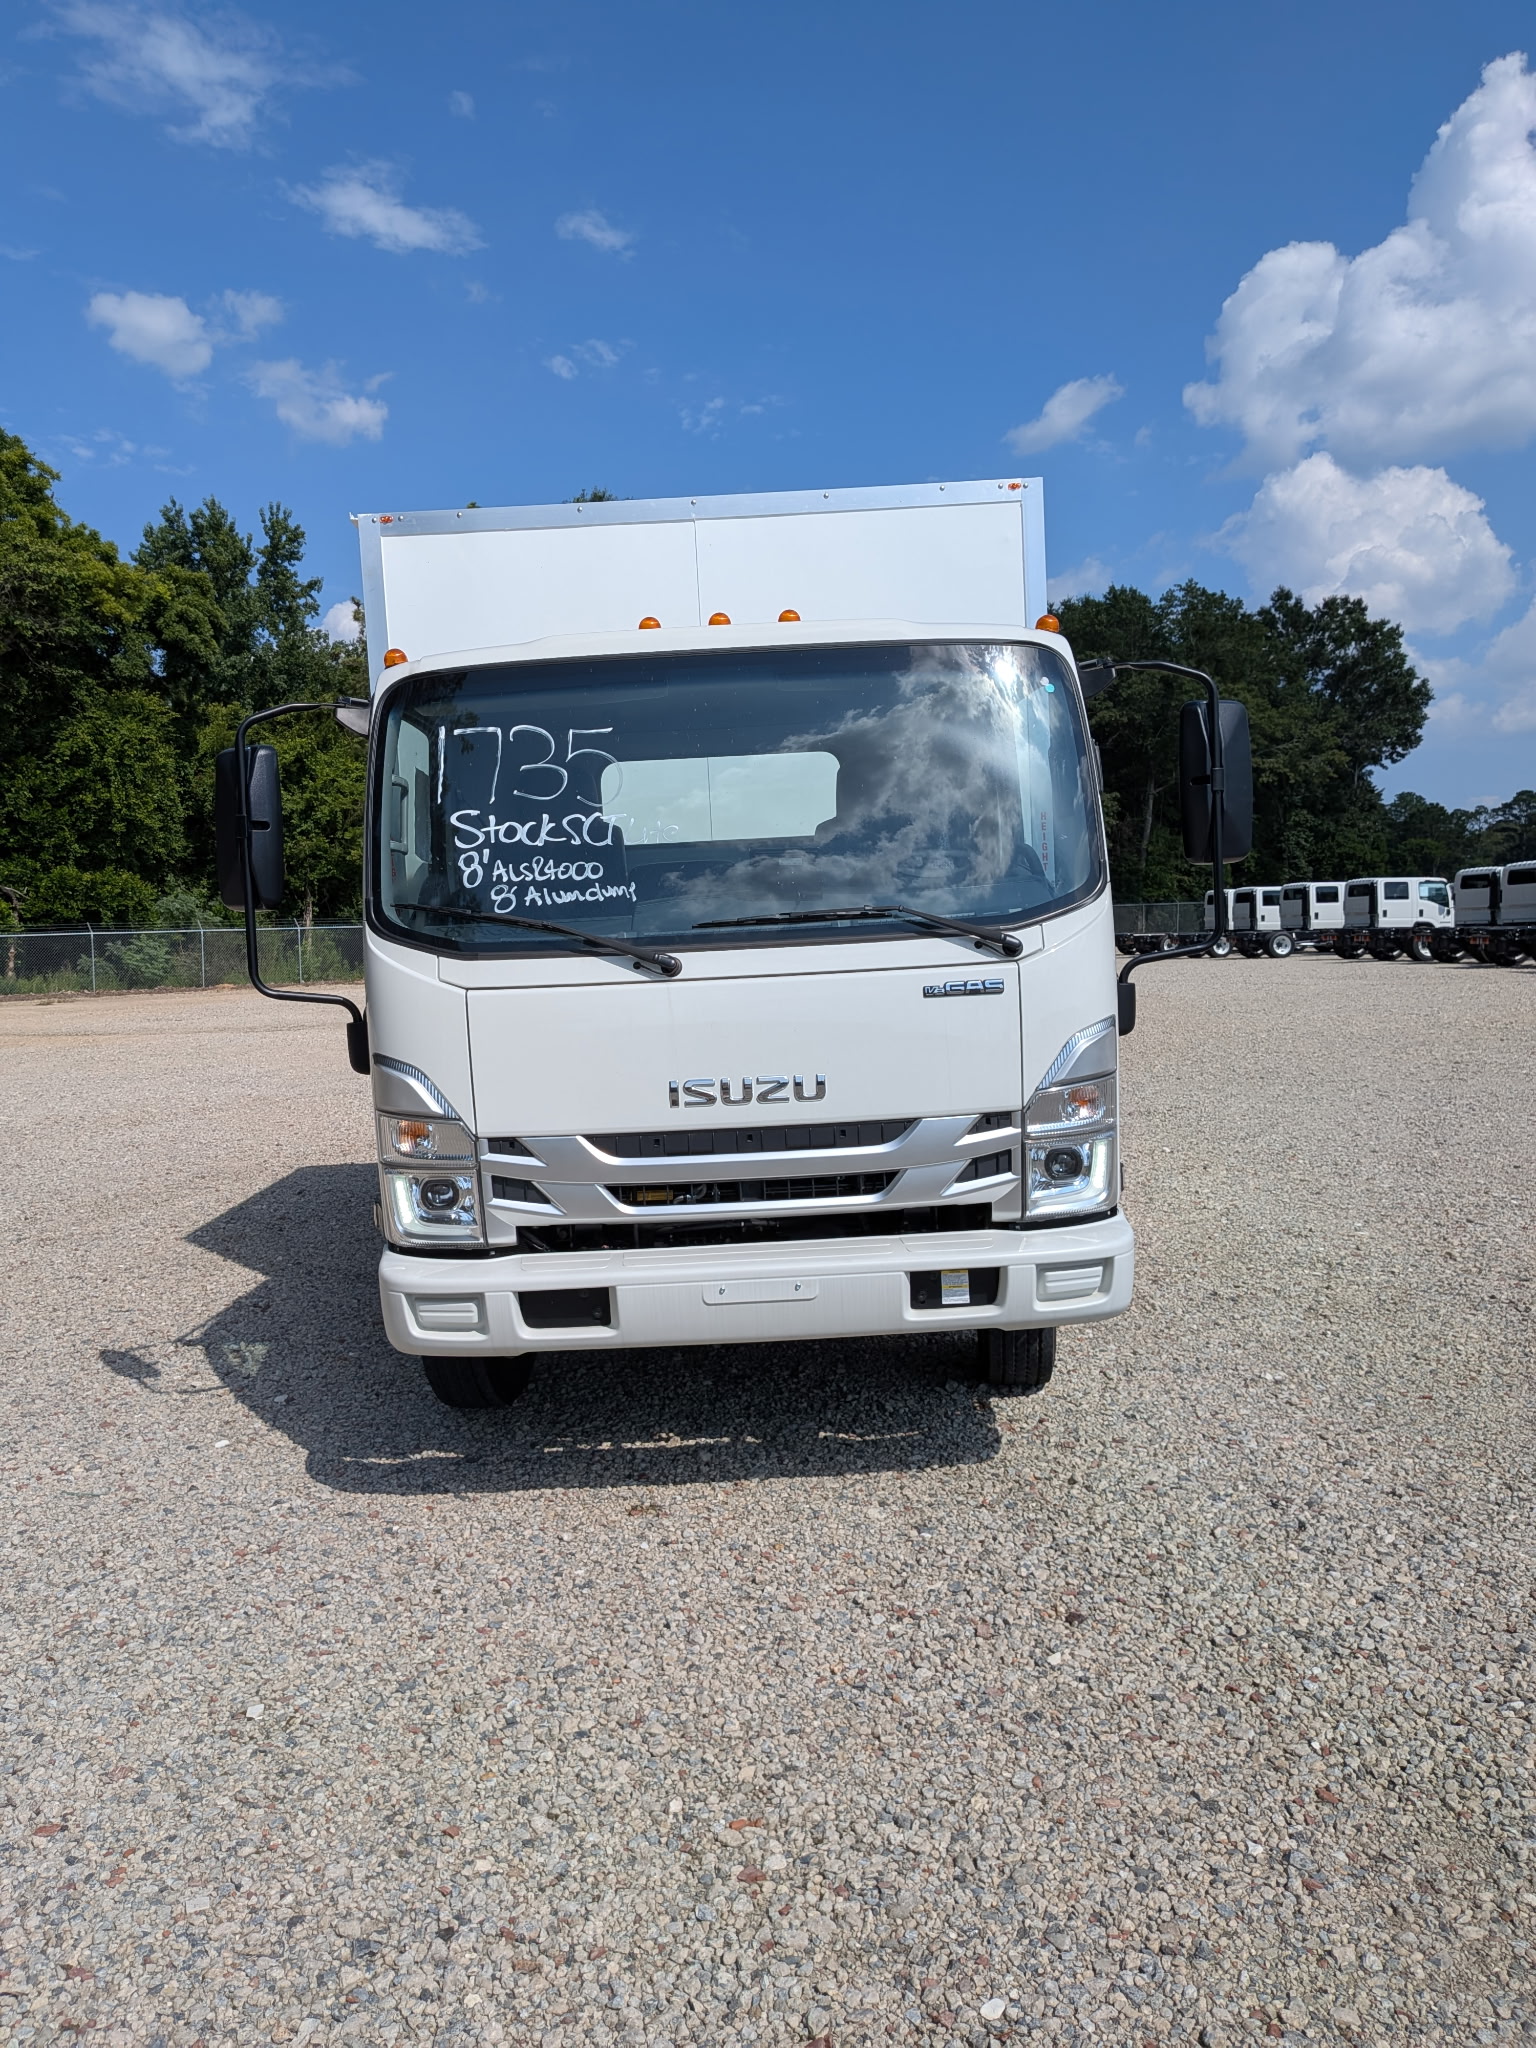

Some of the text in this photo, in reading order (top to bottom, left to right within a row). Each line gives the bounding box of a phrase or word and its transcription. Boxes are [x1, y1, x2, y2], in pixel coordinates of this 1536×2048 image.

[437, 724, 624, 807] 1735
[1040, 811, 1049, 873] HEIGHT
[944, 978, 1005, 996] GAS
[668, 1073, 827, 1109] ISUZU
